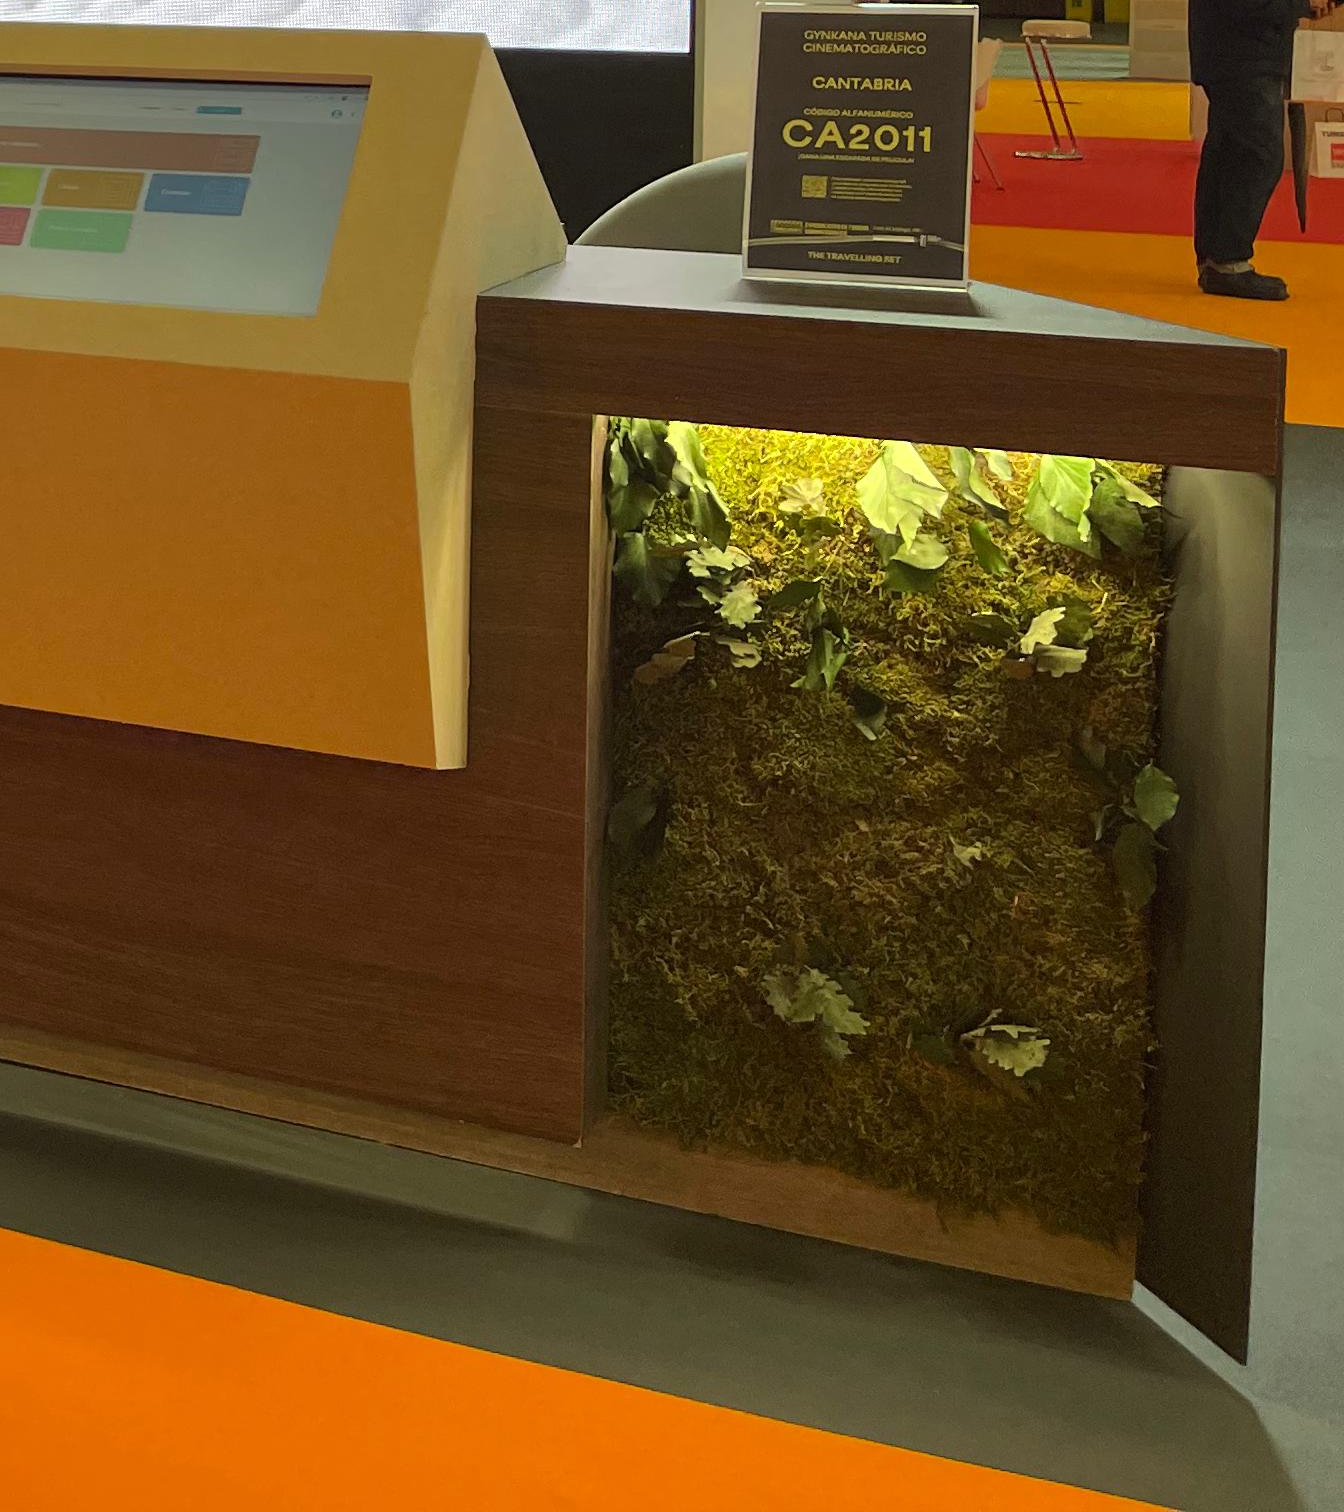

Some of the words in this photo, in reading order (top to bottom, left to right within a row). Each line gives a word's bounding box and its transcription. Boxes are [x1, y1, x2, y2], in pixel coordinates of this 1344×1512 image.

[803, 30, 867, 41] GYNKANA
[869, 31, 927, 42] TURISMO
[802, 42, 927, 55] CINEMATOGRÁFICO
[812, 76, 912, 92] CANTABRIA
[782, 119, 932, 153] CA2011
[807, 251, 825, 260] THE
[826, 252, 883, 263] TRAVELLING
